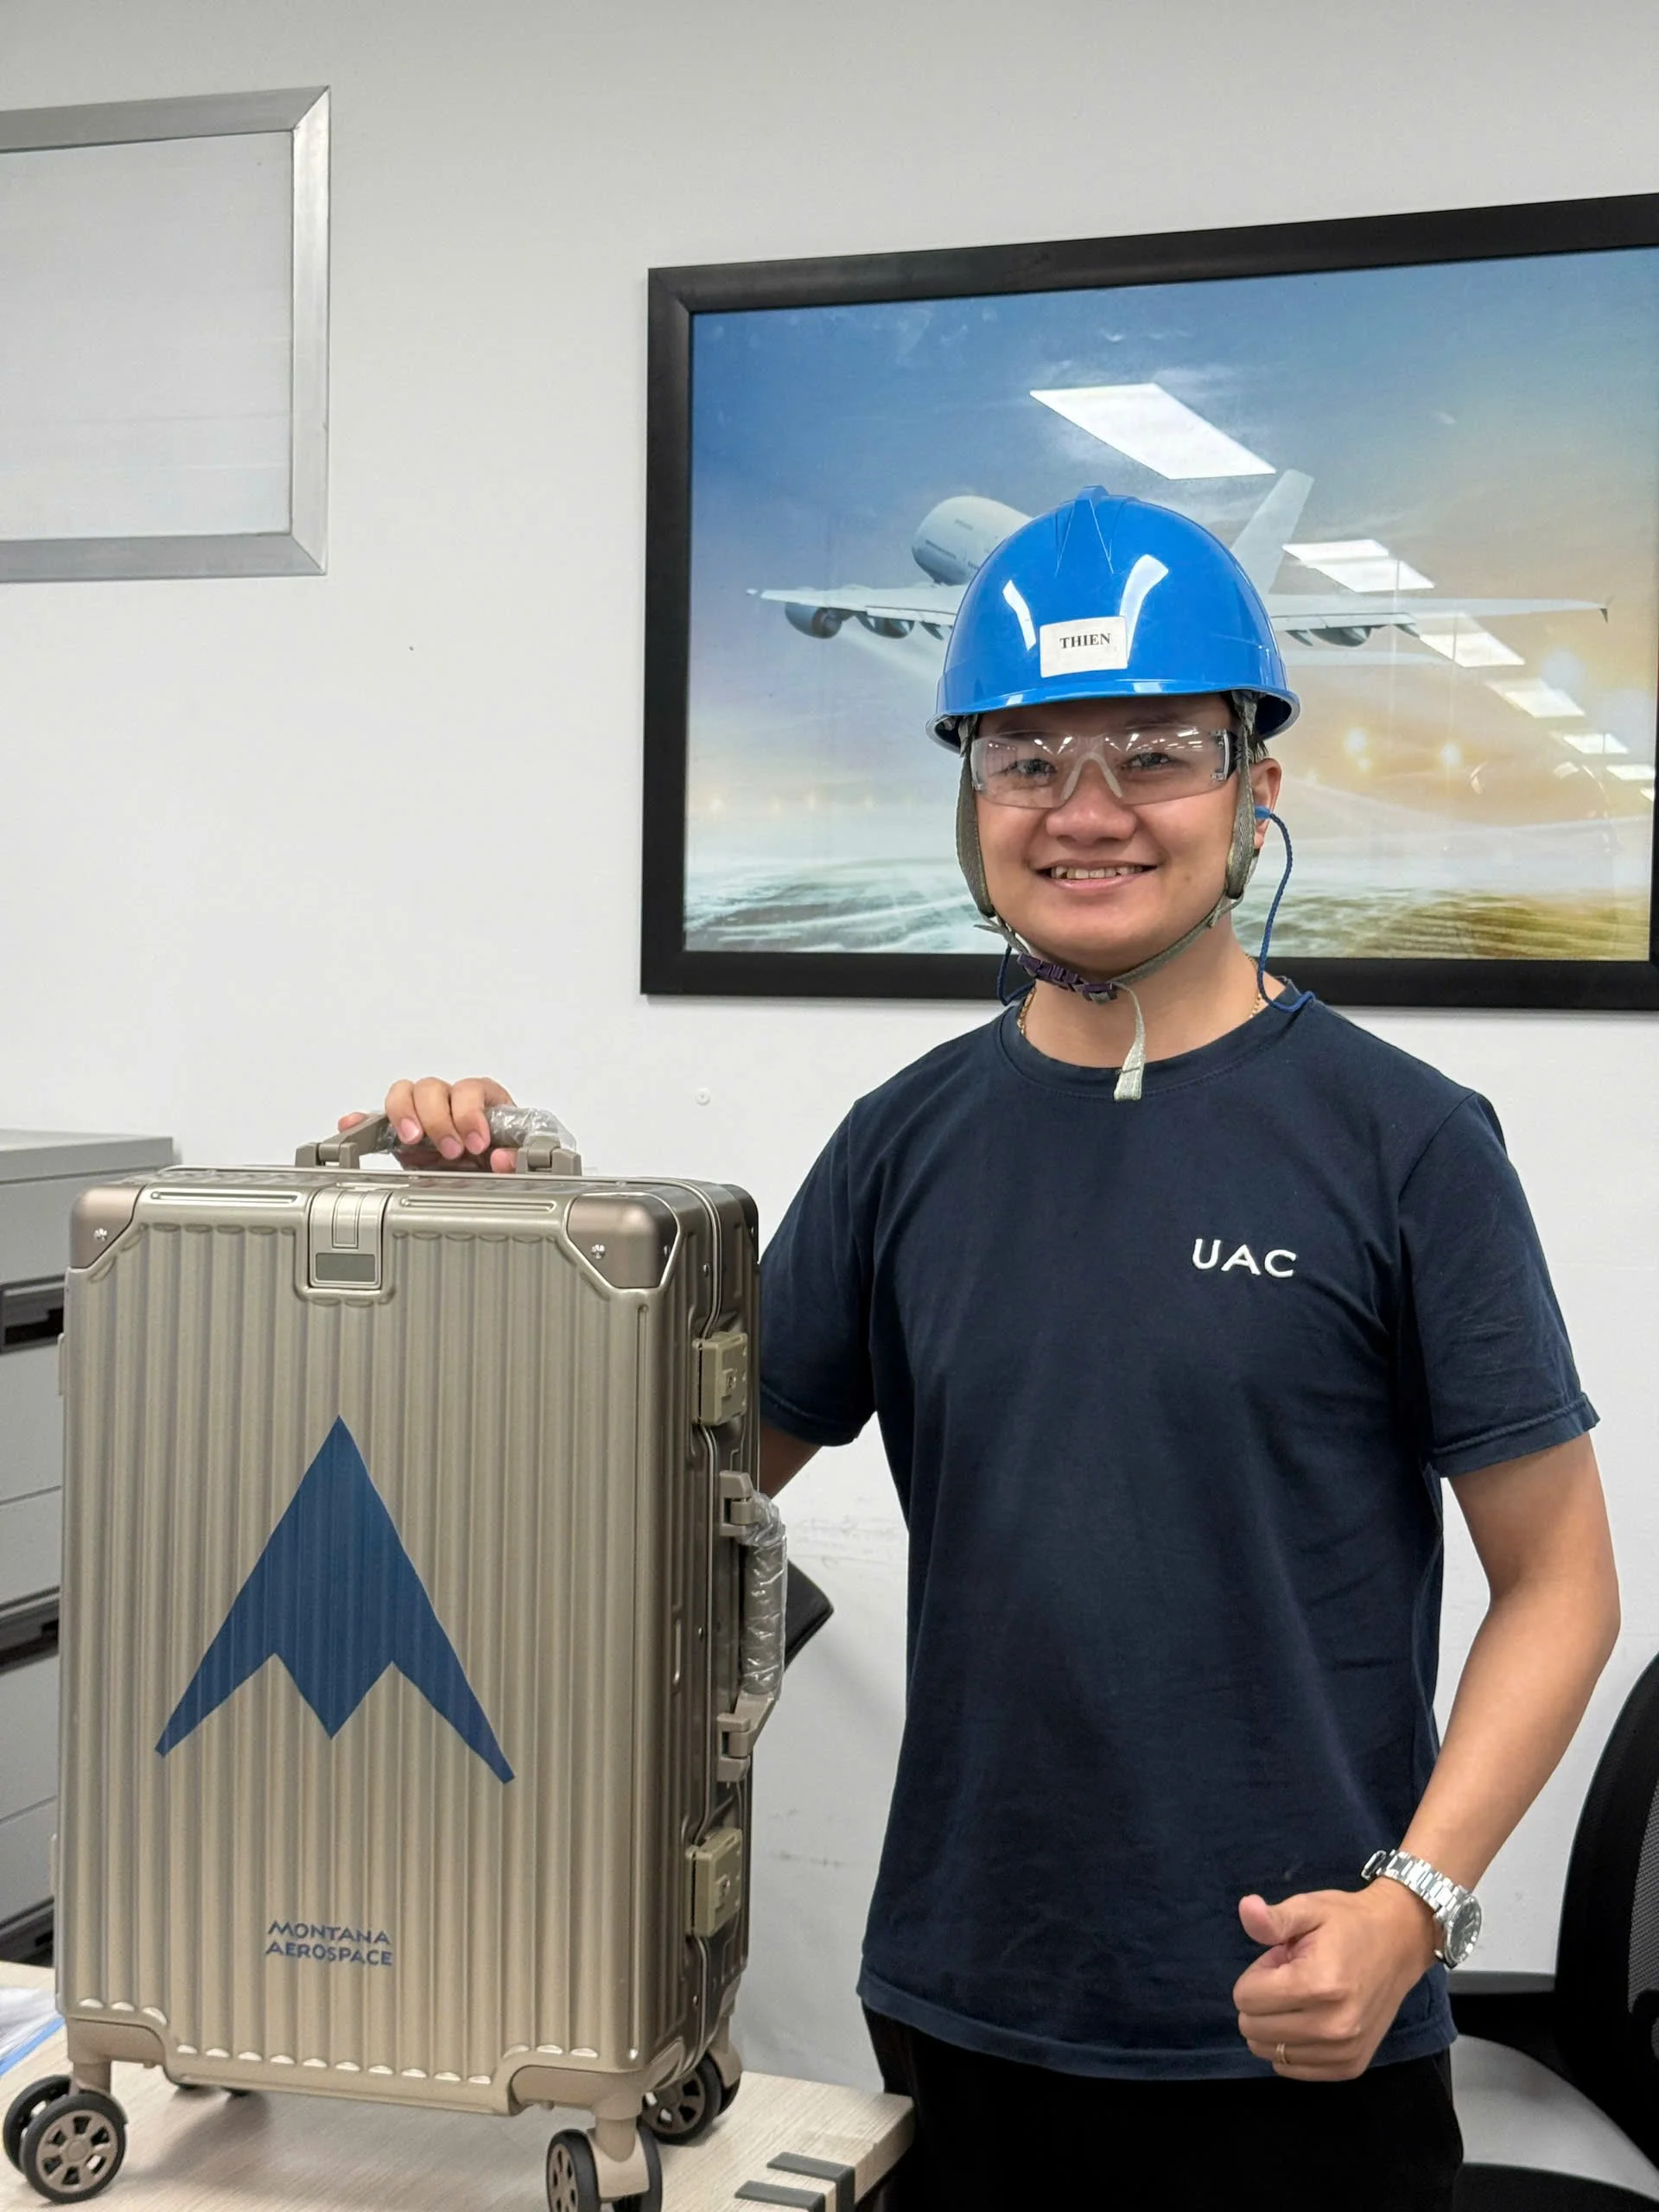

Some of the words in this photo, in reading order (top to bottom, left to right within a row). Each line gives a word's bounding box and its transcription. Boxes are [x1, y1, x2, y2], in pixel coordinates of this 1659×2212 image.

[1059, 632, 1111, 649] THIEN
[1192, 1238, 1297, 1278] UAC
[268, 1920, 391, 1945] MONTANA
[265, 1940, 393, 1967] AEROSPACE
